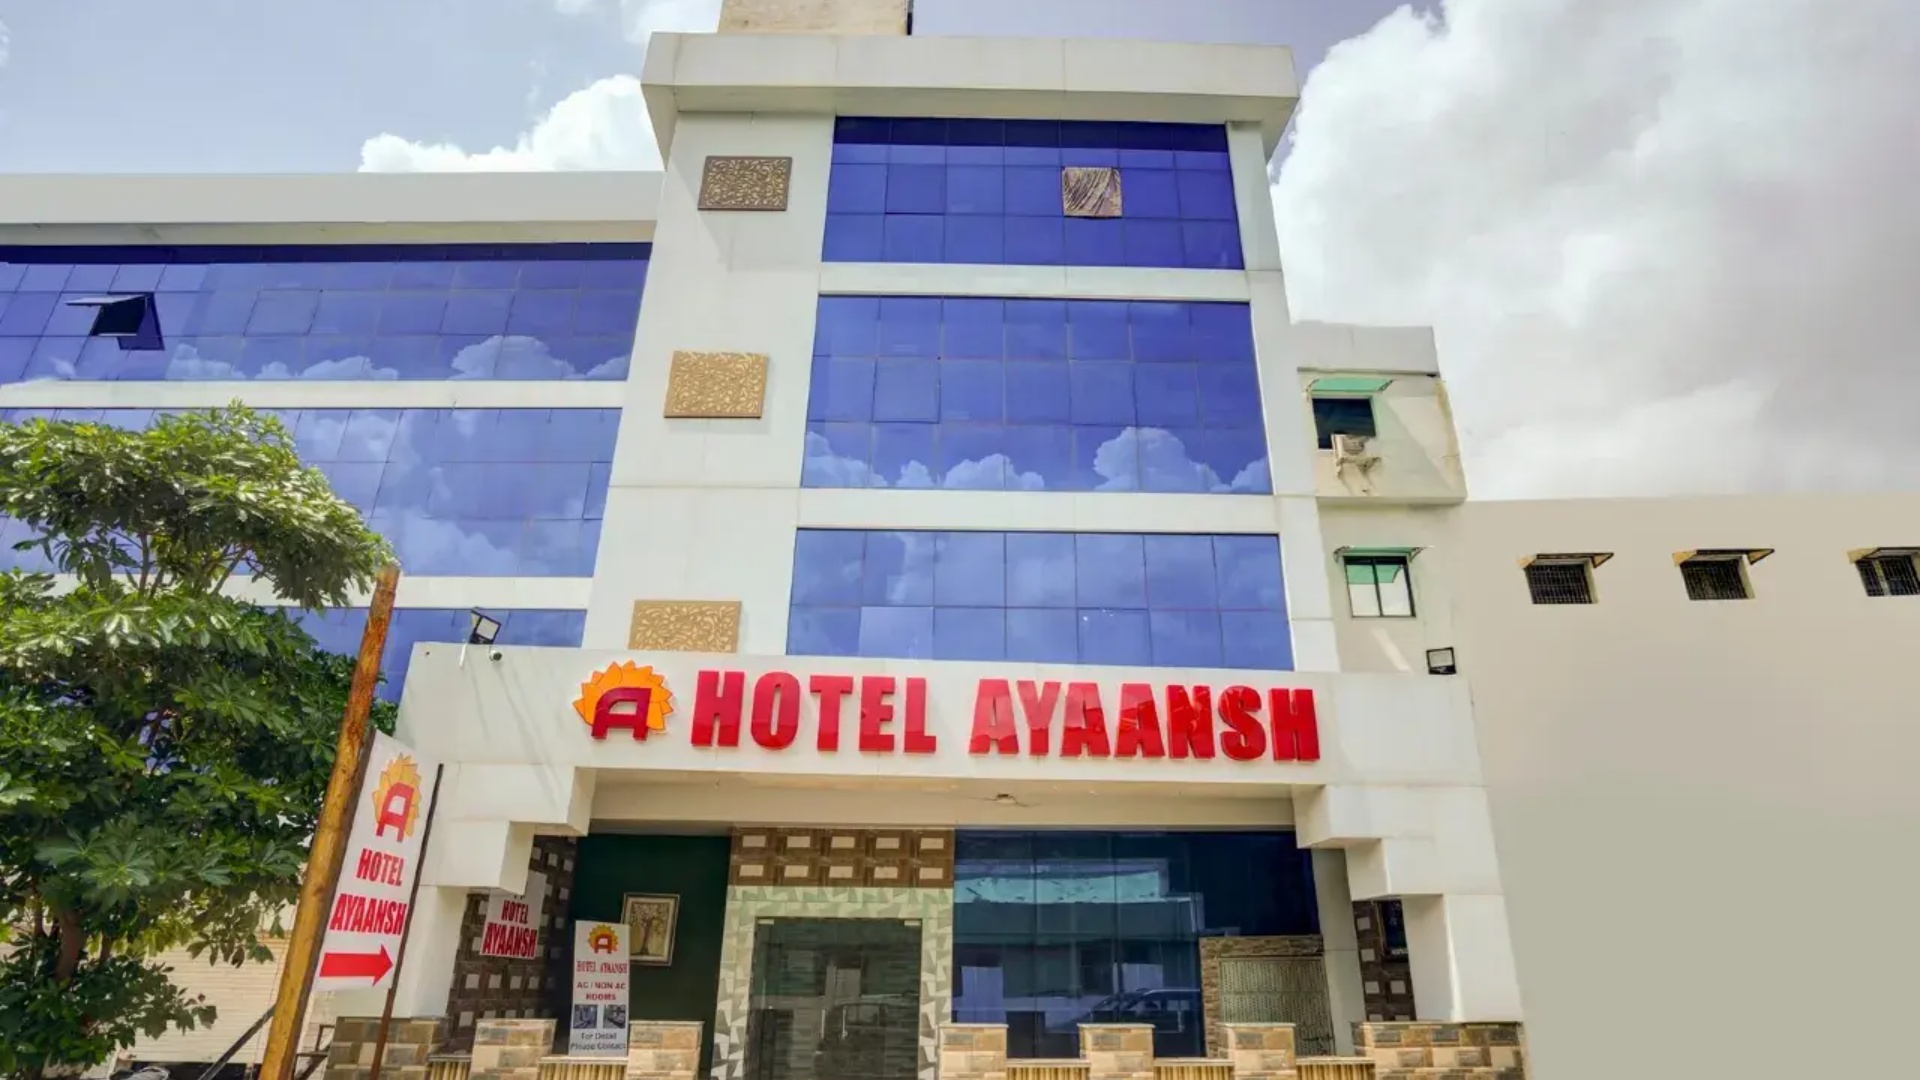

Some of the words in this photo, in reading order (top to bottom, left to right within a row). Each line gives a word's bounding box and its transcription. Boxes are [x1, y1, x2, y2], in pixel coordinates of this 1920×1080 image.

[690, 669, 936, 755] HOTEL
[969, 678, 1321, 762] AYAANSH
[356, 848, 404, 887] HOTEL
[329, 893, 407, 936] AYAANSH
[501, 900, 529, 925] HOTEL
[481, 921, 537, 957] AYAANSH
[576, 960, 596, 973] HOTEL
[586, 993, 616, 1001] ROOMS
